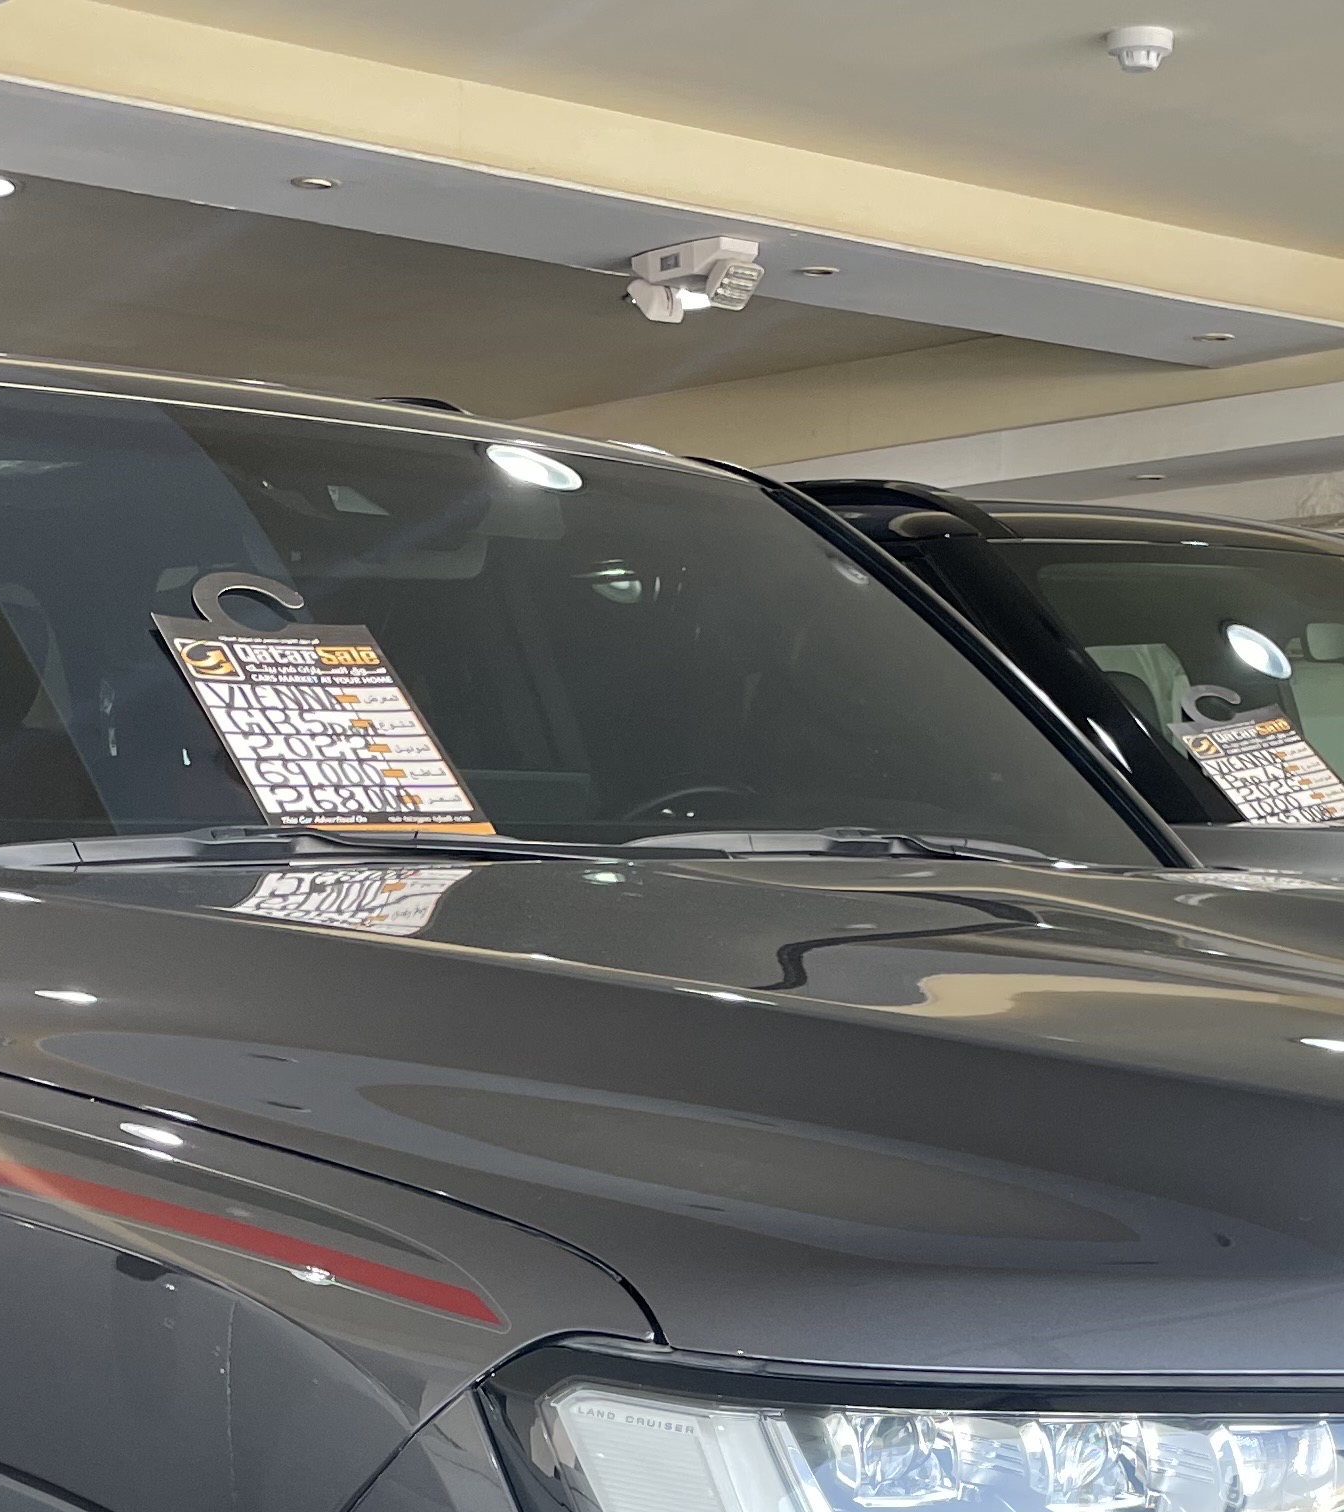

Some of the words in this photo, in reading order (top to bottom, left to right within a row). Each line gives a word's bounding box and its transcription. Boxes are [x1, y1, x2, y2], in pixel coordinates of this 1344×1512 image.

[278, 675, 319, 684] MARKET
[362, 676, 393, 684] HOME
[206, 684, 346, 711] VIENNA
[577, 1406, 616, 1420] LAND
[625, 1415, 695, 1434] CRUISER
